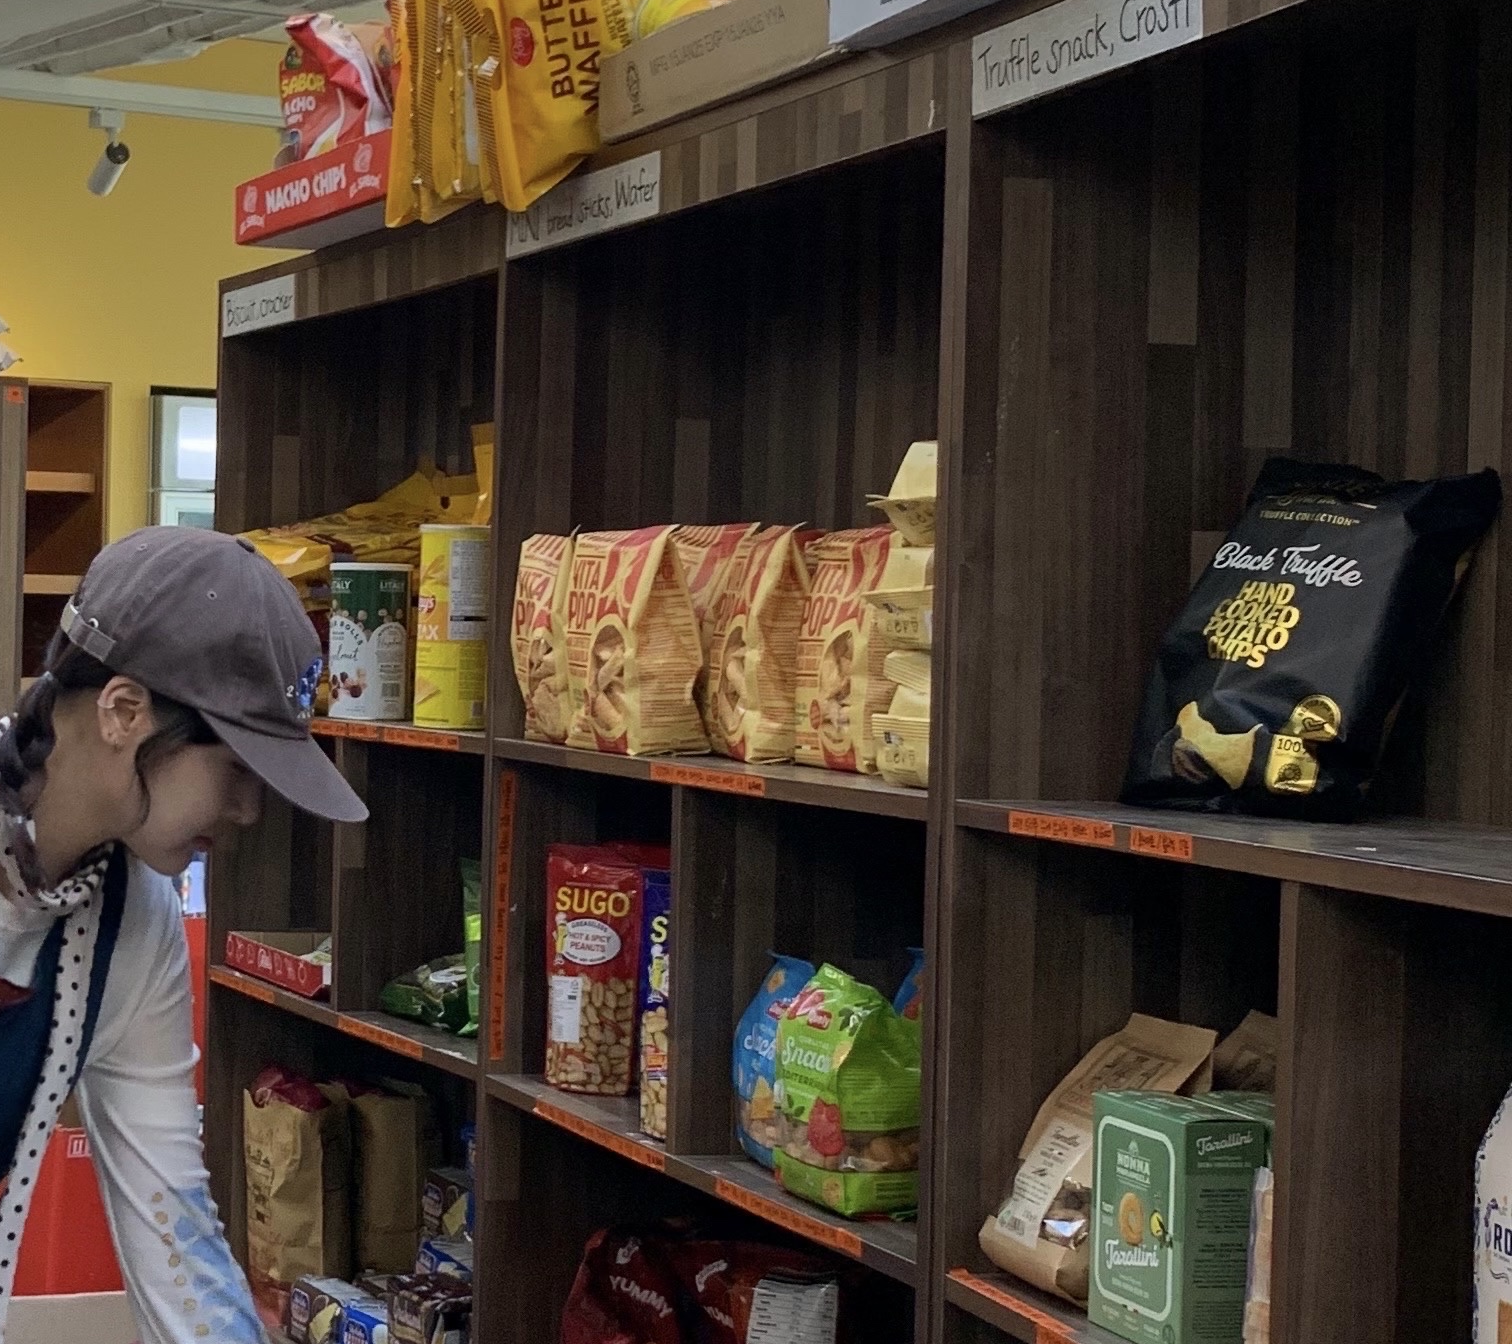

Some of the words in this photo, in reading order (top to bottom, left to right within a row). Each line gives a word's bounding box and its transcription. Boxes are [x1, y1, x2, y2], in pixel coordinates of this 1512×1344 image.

[977, 35, 1042, 92] Truffle
[264, 176, 311, 215] NACHO
[312, 162, 348, 200] CHIPS
[615, 167, 659, 212] Wafer
[1259, 509, 1296, 521] TRUFFLE
[572, 558, 602, 591] VITA
[1213, 541, 1279, 572] Black
[1280, 543, 1364, 588] Truffle
[569, 590, 597, 628] POP
[1237, 579, 1297, 606] HAND
[1214, 598, 1301, 630] COOKED
[1203, 616, 1290, 651] POTATO
[1208, 635, 1269, 669] CHIPS
[555, 885, 631, 918] SUGO
[568, 932, 583, 943] HOT
[590, 934, 612, 945] SPICY
[570, 941, 606, 954] PEANUTS
[1104, 1238, 1161, 1270] Tarallini
[608, 1275, 674, 1320] YUMMY
